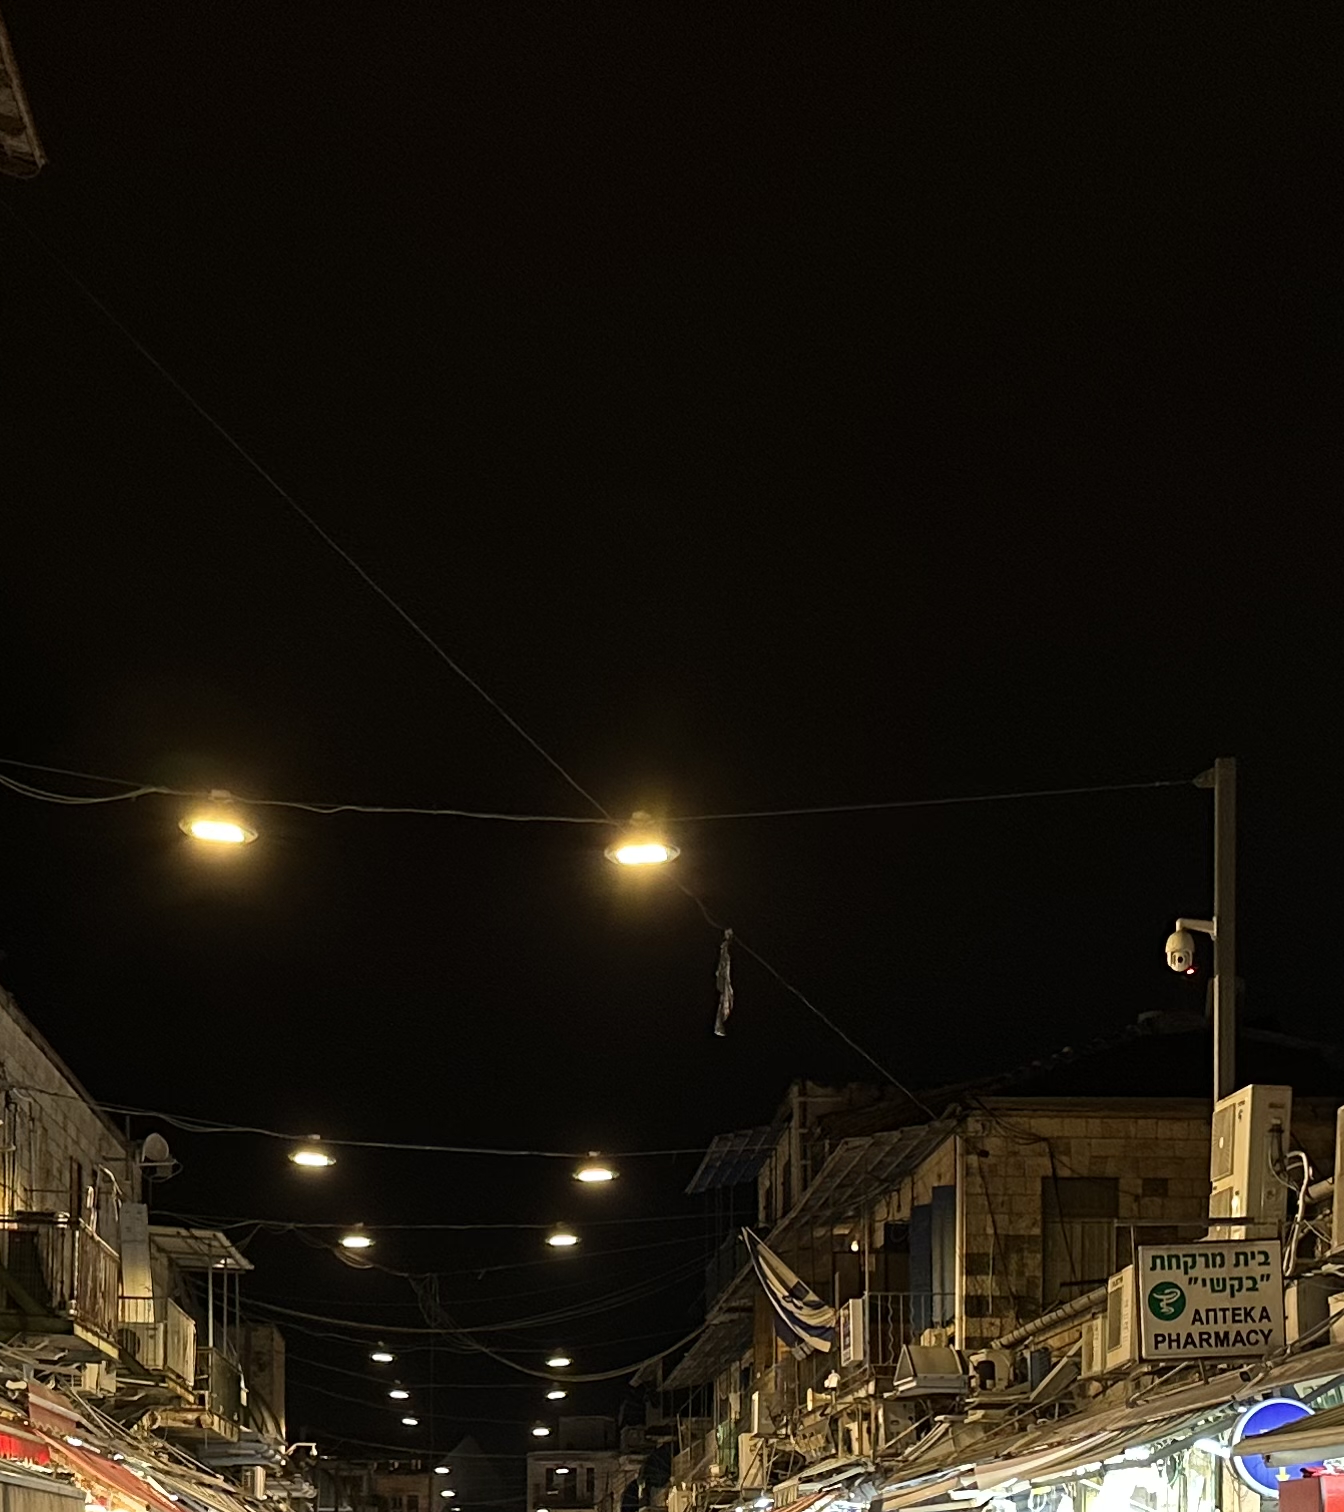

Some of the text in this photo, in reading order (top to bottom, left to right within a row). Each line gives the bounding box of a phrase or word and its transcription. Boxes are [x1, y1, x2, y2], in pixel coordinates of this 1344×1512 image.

[1149, 1250, 1271, 1276] בית מרקחת
[1191, 1306, 1271, 1326] АПТЕКА
[1153, 1328, 1273, 1350] PHARMACY
